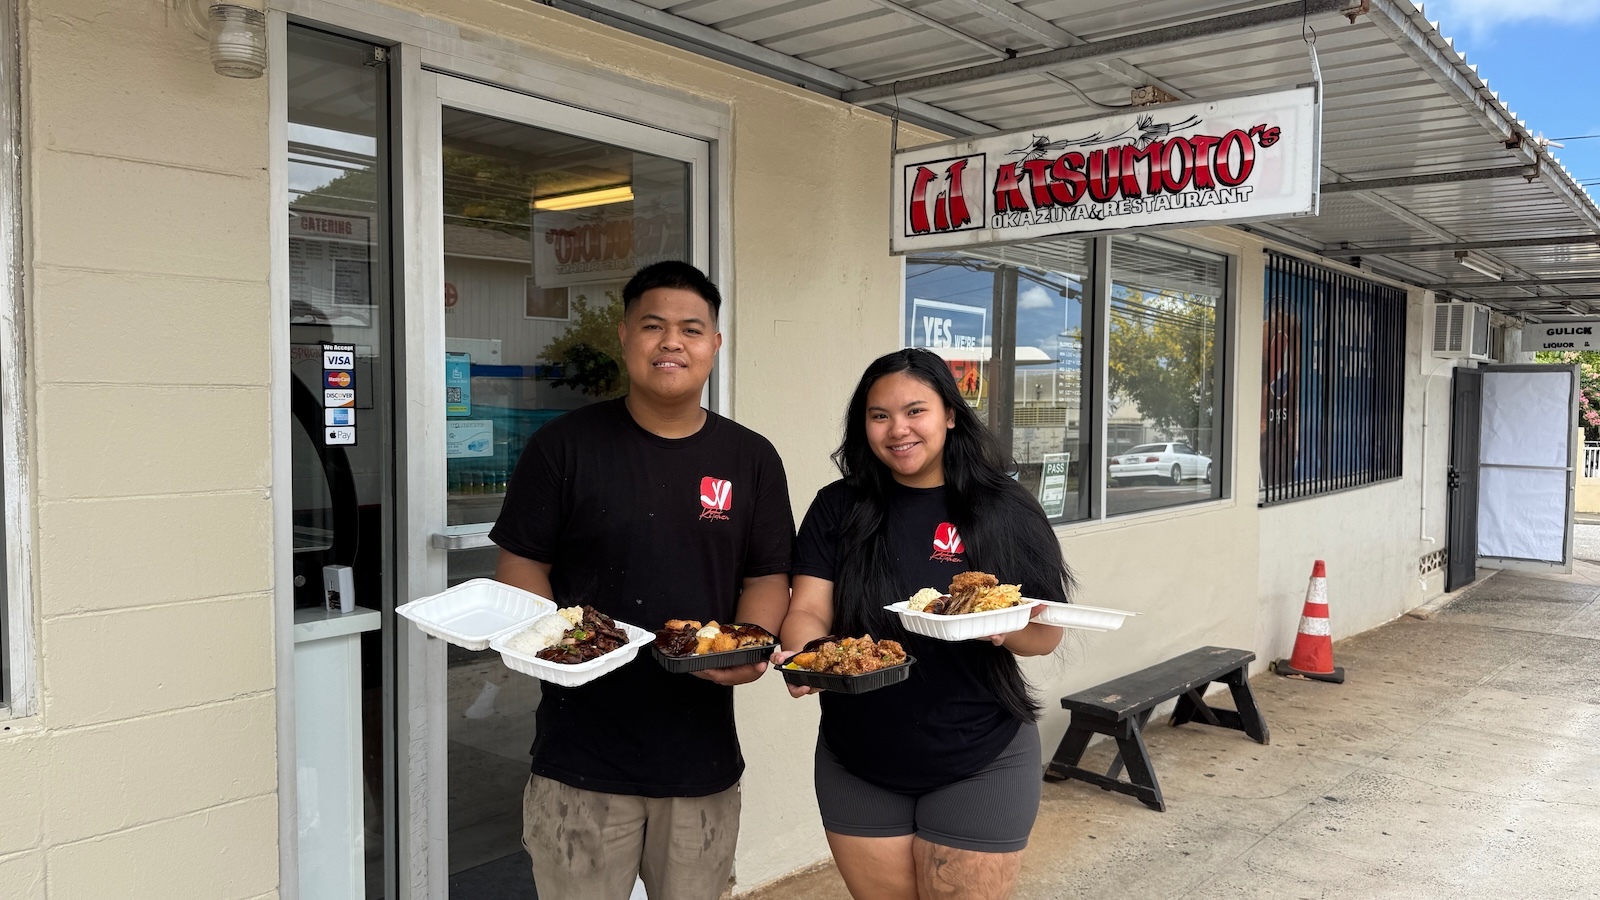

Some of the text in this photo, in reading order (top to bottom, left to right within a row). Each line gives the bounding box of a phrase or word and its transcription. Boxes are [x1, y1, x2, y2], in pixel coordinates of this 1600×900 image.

[1103, 185, 1254, 217] RESTAURANT
[300, 216, 353, 235] CATERING
[923, 316, 976, 351] YES WE'RE
[1546, 327, 1592, 336] GULICK
[327, 356, 351, 365] VISA
[337, 430, 351, 441] Pay
[1047, 463, 1065, 474] PASS
